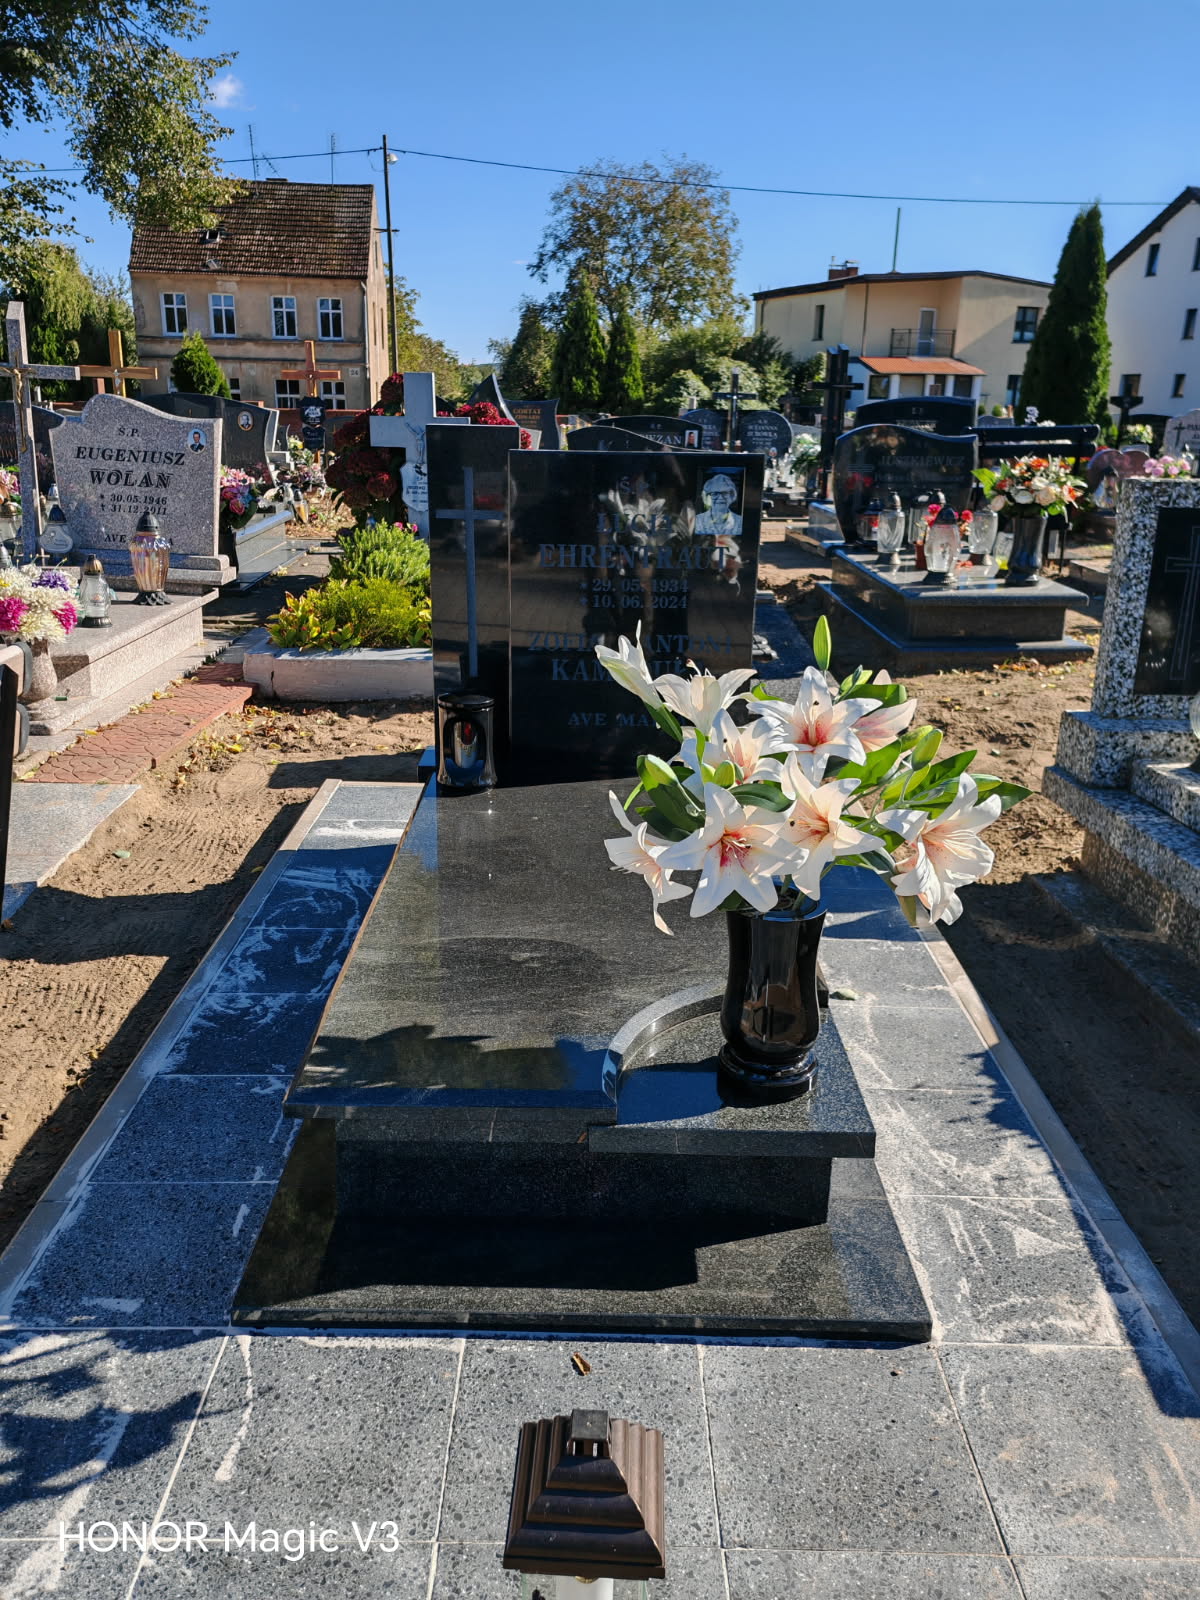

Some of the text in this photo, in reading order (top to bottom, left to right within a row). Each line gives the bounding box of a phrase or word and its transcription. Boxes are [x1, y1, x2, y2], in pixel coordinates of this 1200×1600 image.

[75, 446, 186, 466] EUGENIUSZ
[110, 494, 168, 505] 30.05.1946
[104, 534, 127, 543] AVE
[539, 543, 729, 569] EHRENTRAUT
[568, 712, 608, 725] AVE
